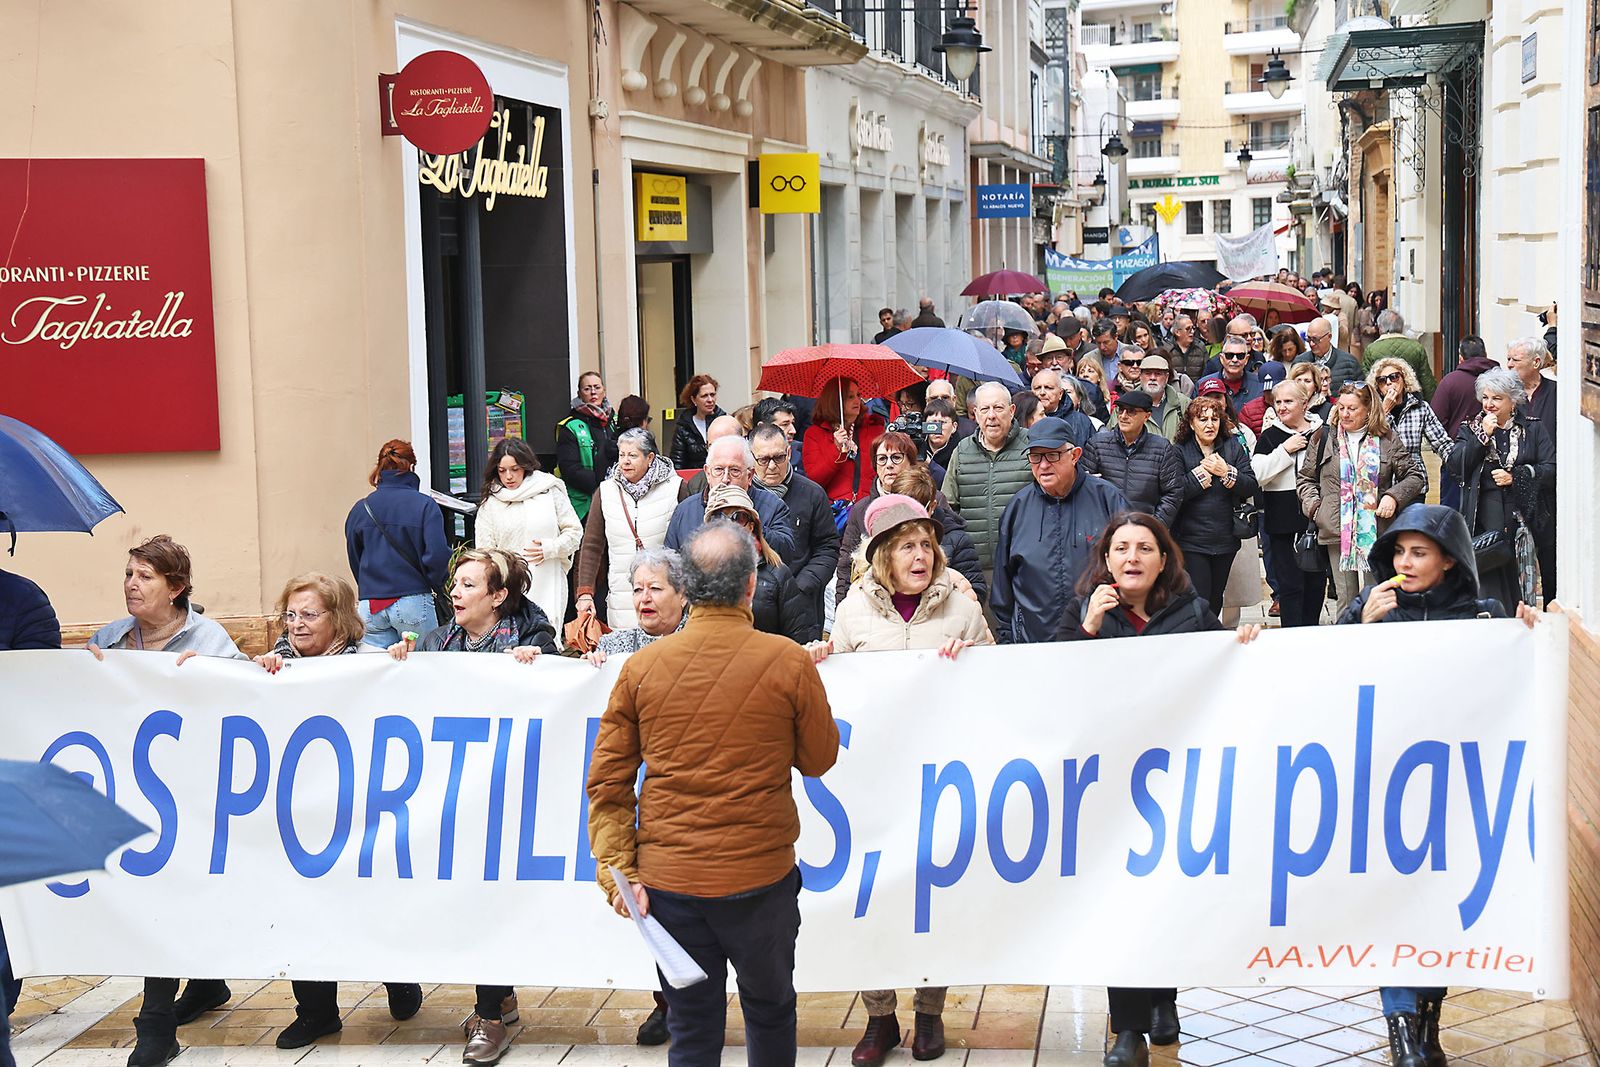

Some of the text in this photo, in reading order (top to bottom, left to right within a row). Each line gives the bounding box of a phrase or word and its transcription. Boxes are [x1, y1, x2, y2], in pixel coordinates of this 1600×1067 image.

[409, 86, 473, 96] RISTORANTI PIZZERIE
[401, 96, 484, 118] La Tagliatella
[457, 108, 548, 211] Tagliatella
[1142, 177, 1175, 189] RURAL
[1177, 176, 1197, 187] DEL
[1199, 175, 1220, 186] SUR
[981, 191, 1025, 201] NOTARÍA
[0, 265, 150, 283] ORANTI PIZZERIE
[1, 291, 193, 350] Tagliatella
[915, 754, 1099, 933] por
[1127, 746, 1236, 877] su
[1270, 685, 1536, 930] play
[1247, 944, 1534, 973] AA.VV. Portile
